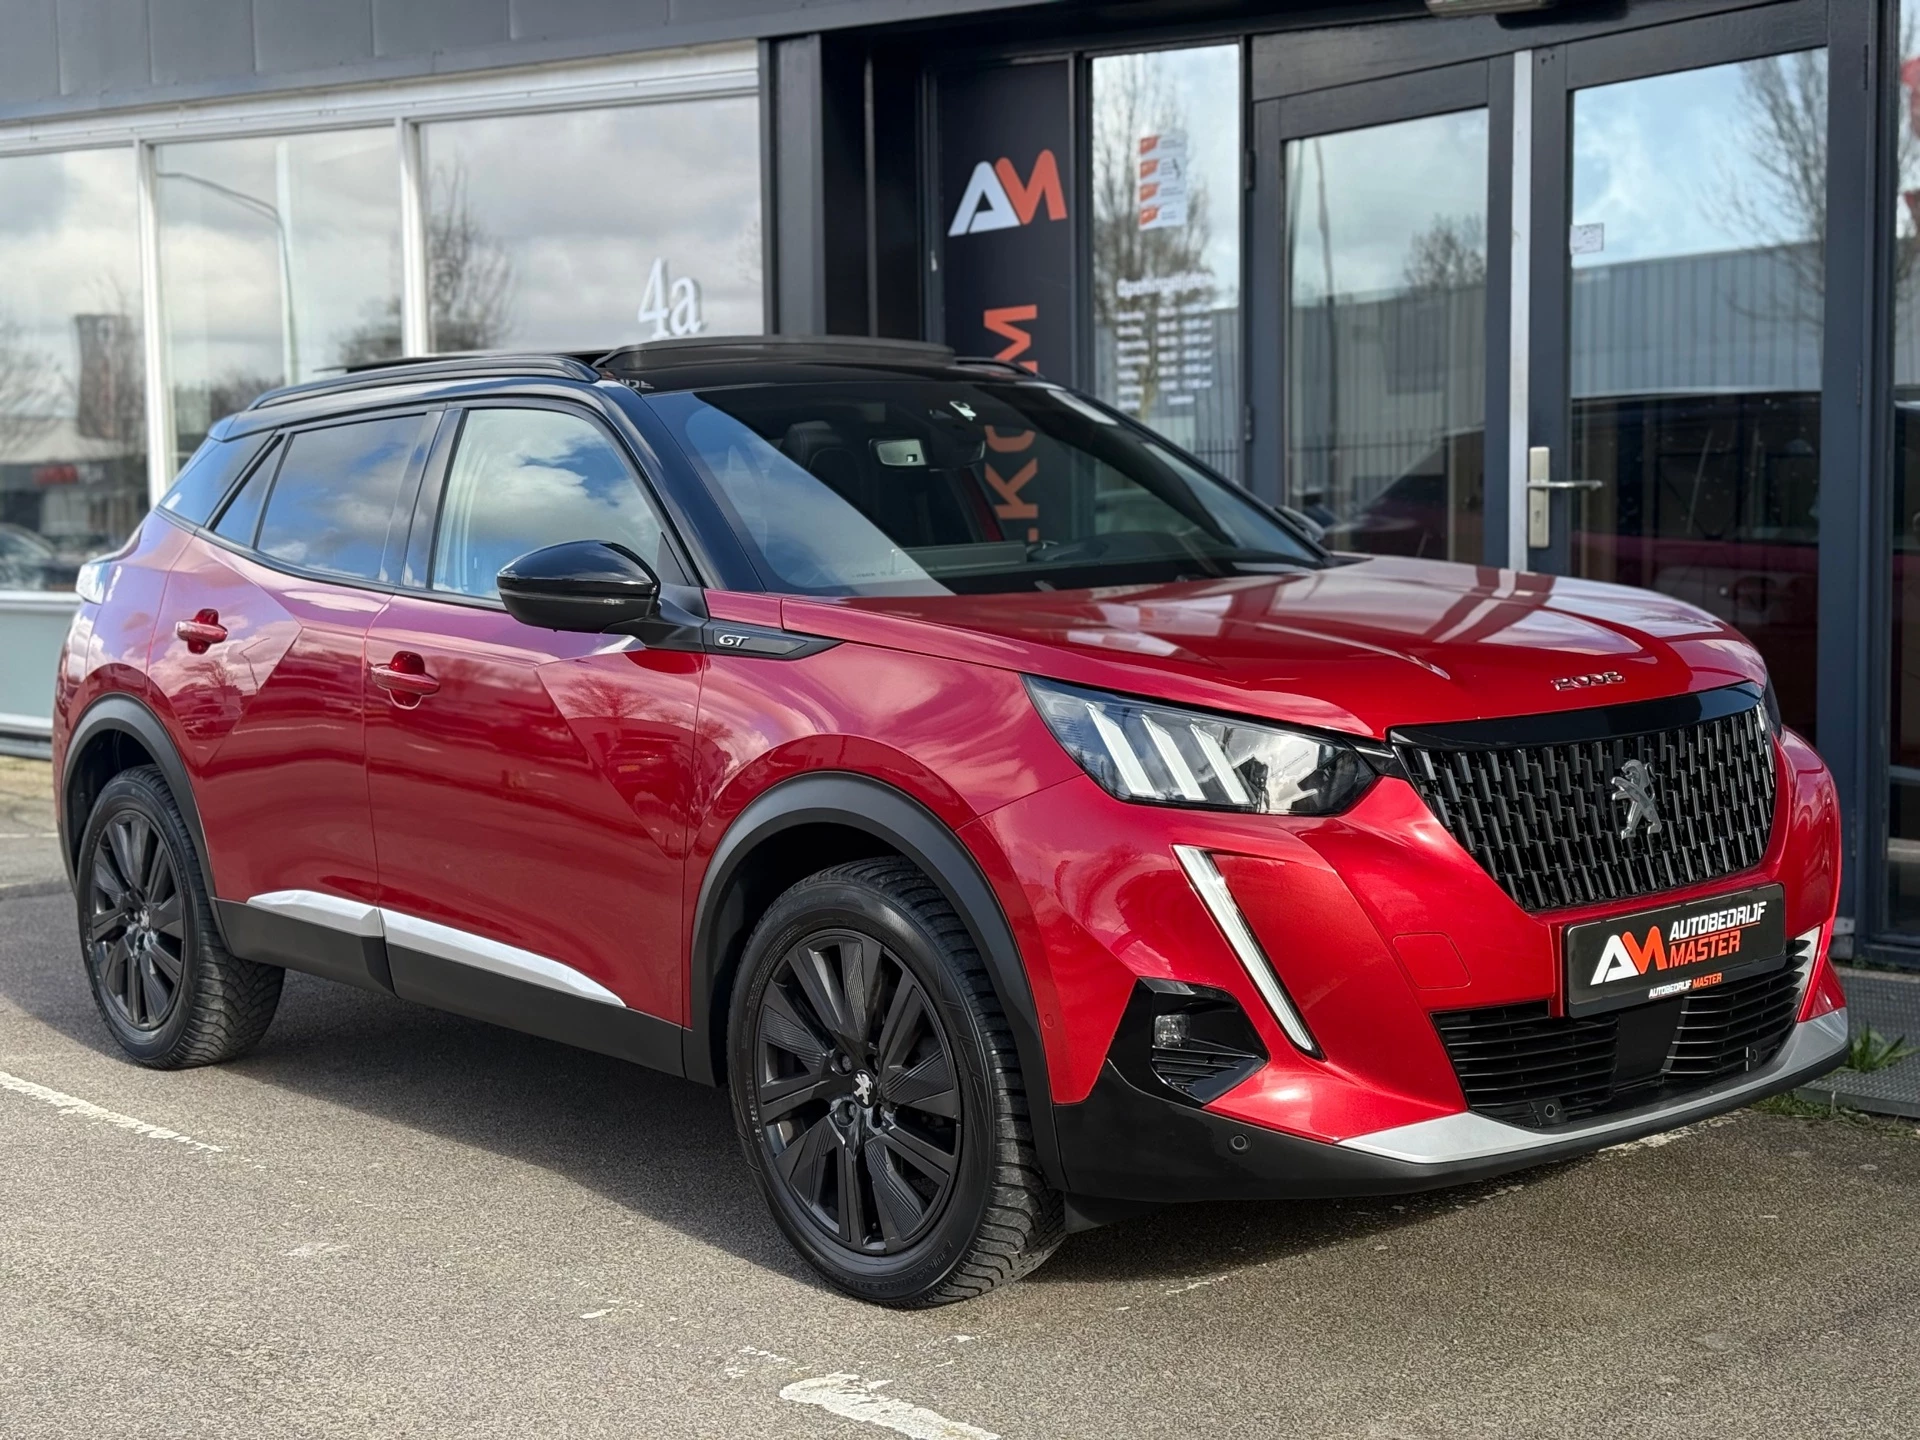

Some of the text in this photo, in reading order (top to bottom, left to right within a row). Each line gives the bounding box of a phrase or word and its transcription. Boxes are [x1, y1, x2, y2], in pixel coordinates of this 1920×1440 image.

[948, 149, 1067, 237] AM
[638, 256, 701, 340] 4a
[718, 634, 750, 647] GT
[1550, 671, 1626, 691] 2008
[1668, 901, 1768, 942] AUTOBEDRIJF
[1590, 925, 1668, 986] AM
[1669, 929, 1741, 969] MASTER
[1648, 972, 1723, 999] AUTOBEDRIJF MASTER
